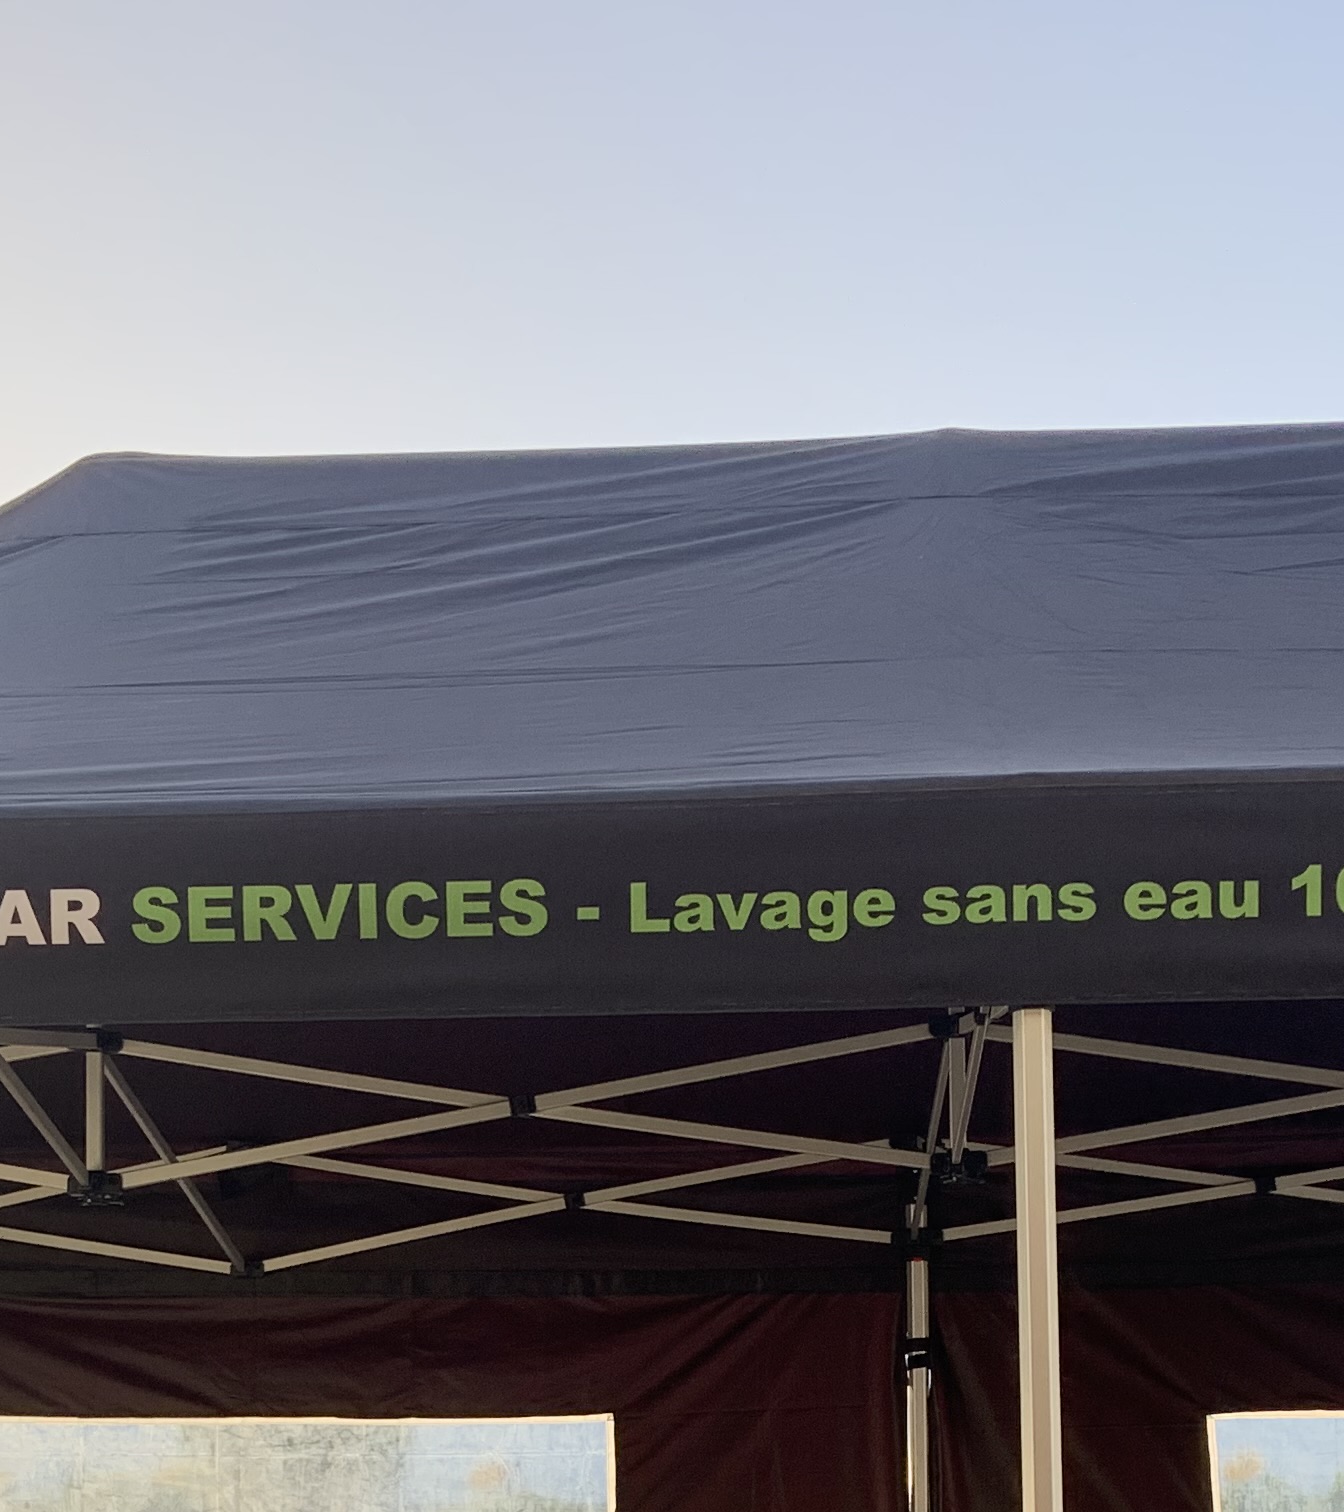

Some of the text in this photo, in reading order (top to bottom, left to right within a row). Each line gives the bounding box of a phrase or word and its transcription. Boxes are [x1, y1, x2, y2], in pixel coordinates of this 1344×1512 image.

[131, 878, 548, 944] SERVICES
[577, 906, 600, 920] -
[630, 882, 896, 942] Lavage
[922, 883, 1097, 925] sans
[1123, 880, 1259, 921] eau
